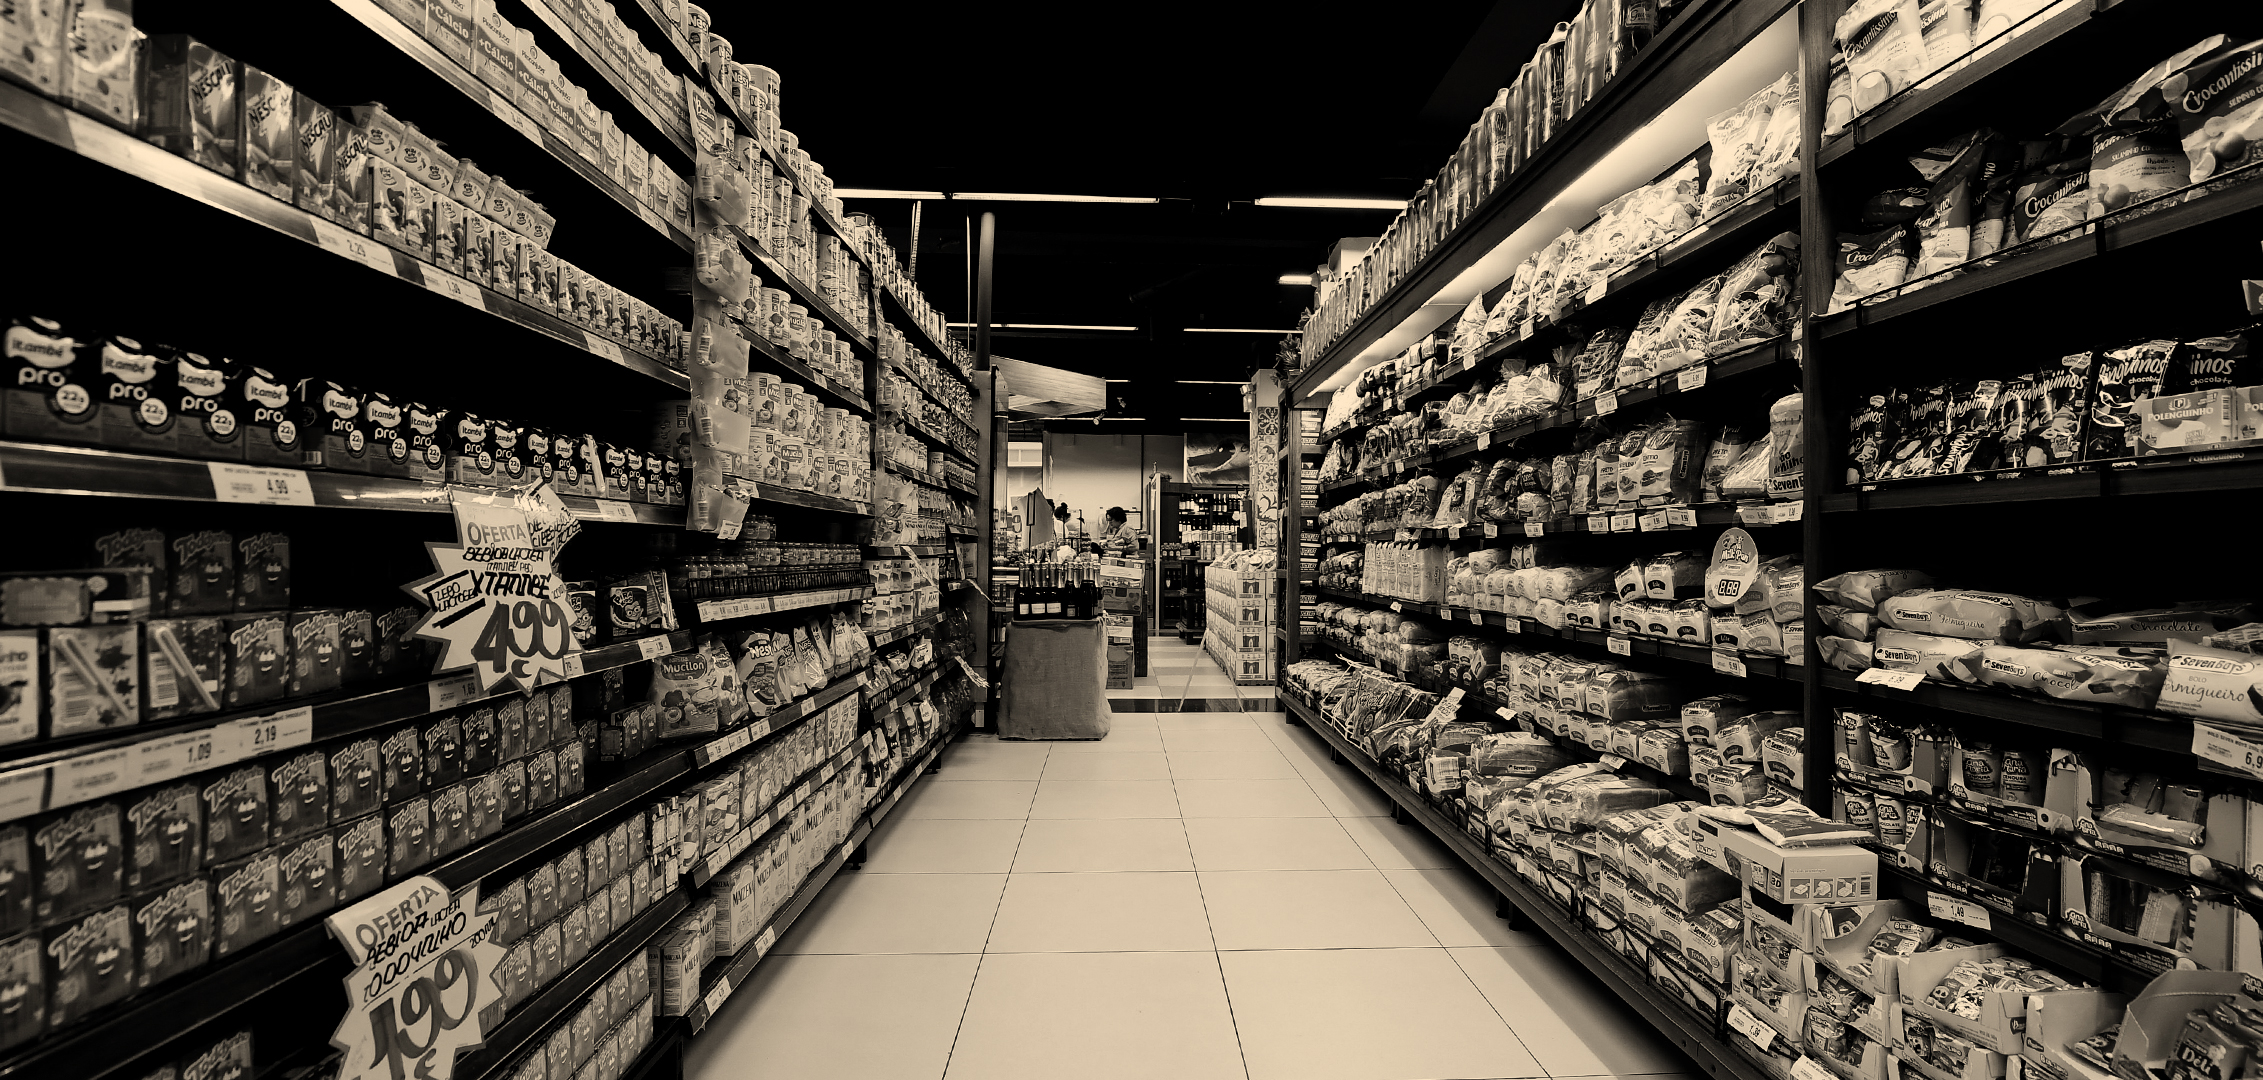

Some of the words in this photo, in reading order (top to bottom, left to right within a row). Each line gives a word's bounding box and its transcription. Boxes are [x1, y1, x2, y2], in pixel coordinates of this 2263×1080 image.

[192, 62, 231, 103] NESCAU
[301, 111, 332, 153] NESCAU
[336, 137, 367, 172] NESCAU
[2190, 377, 2232, 386] chocolate
[251, 387, 284, 401] itambé
[329, 398, 353, 410] itambé
[371, 408, 396, 421] itambé
[411, 416, 434, 428] itambé
[2147, 406, 2214, 422] POLENGUINHO
[467, 521, 526, 545] OFERTA
[292, 611, 340, 651] Toddynho
[2131, 611, 2203, 632] Chocolate
[230, 617, 286, 658] Toddynho
[663, 661, 704, 675] Mucilon
[2188, 675, 2207, 683] BOLO
[254, 725, 277, 746] 2,19
[381, 725, 419, 765] Toddynho
[424, 715, 461, 751] Toddynho
[187, 743, 212, 764] 1,09
[331, 737, 379, 780] Toddynho
[272, 750, 325, 796] Toddynho
[390, 797, 430, 839] Toddynho
[338, 815, 383, 861] Toddynho
[218, 852, 279, 908] Toddynho
[1769, 876, 1782, 888] 3D
[356, 885, 440, 950] OFERTA
[1951, 904, 1965, 917] 1,49
